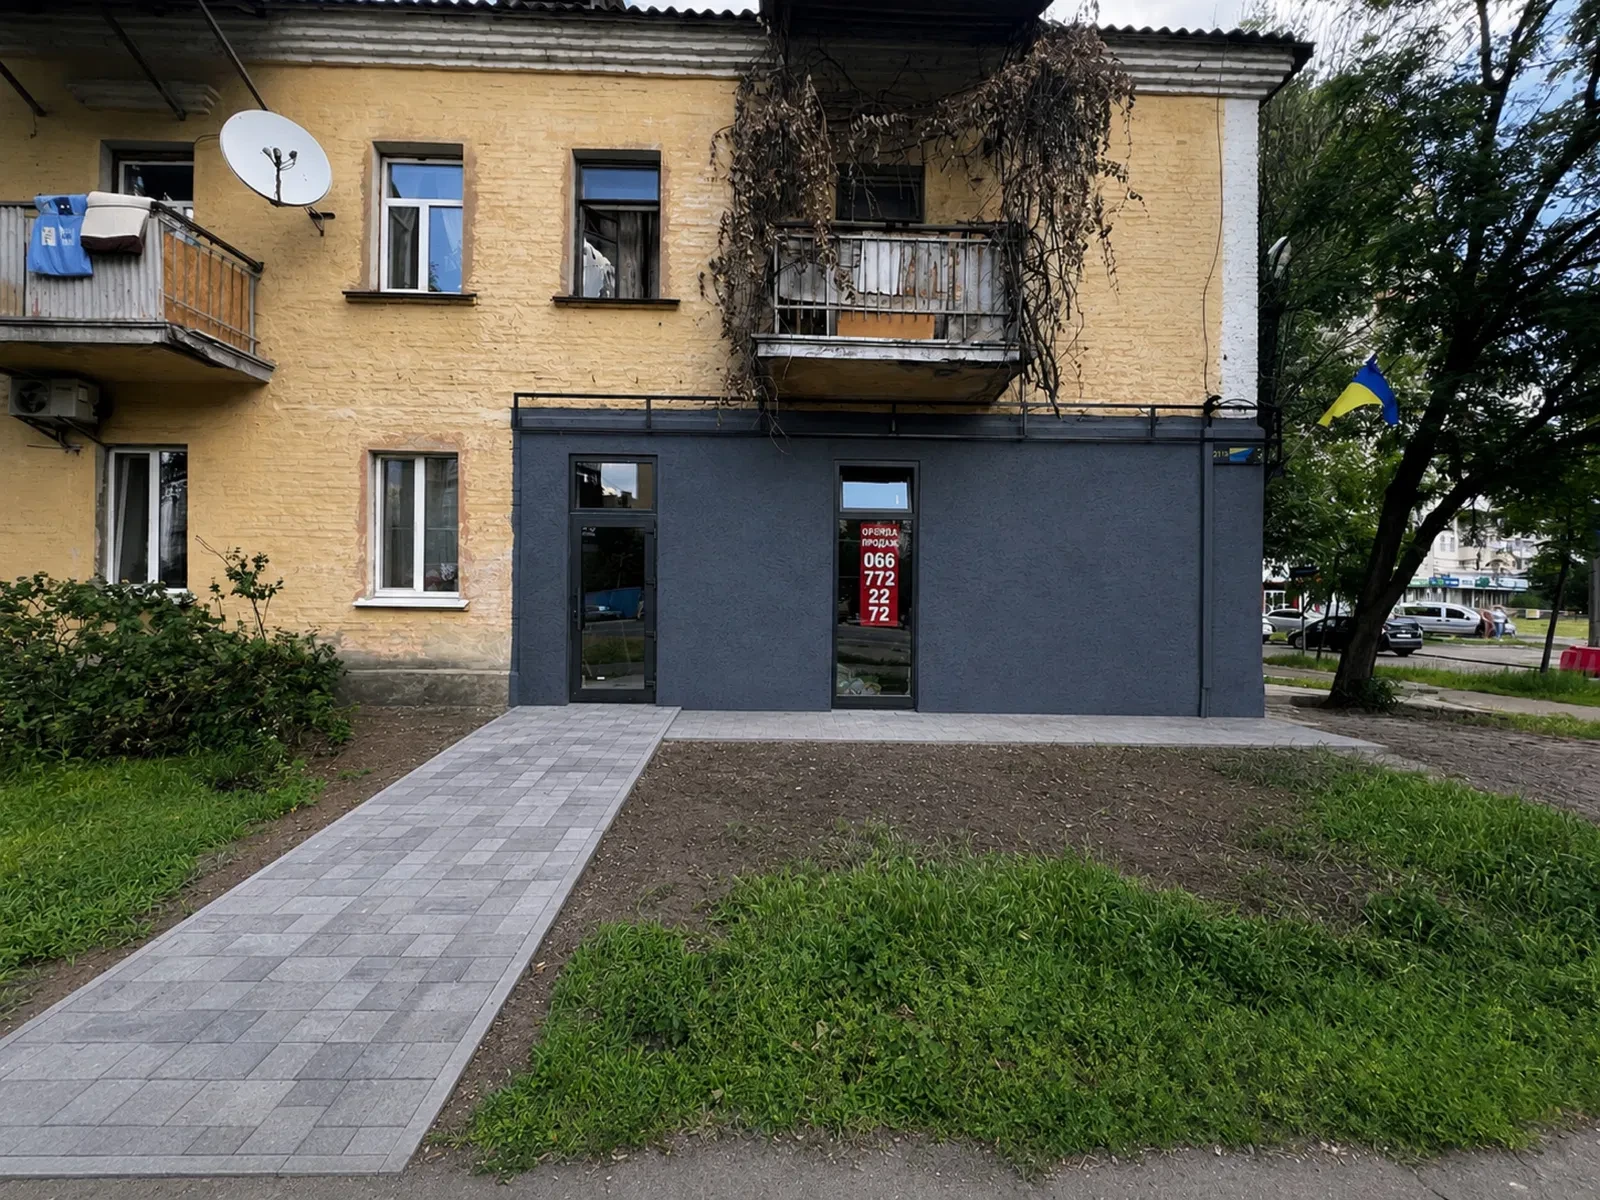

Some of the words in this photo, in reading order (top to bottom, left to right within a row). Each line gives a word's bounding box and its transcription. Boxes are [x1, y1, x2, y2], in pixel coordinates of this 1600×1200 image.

[862, 538, 899, 548] ПРОДАЖ
[864, 552, 895, 568] 066
[864, 571, 895, 586] 772
[868, 588, 890, 604] 22
[868, 606, 890, 622] 72
